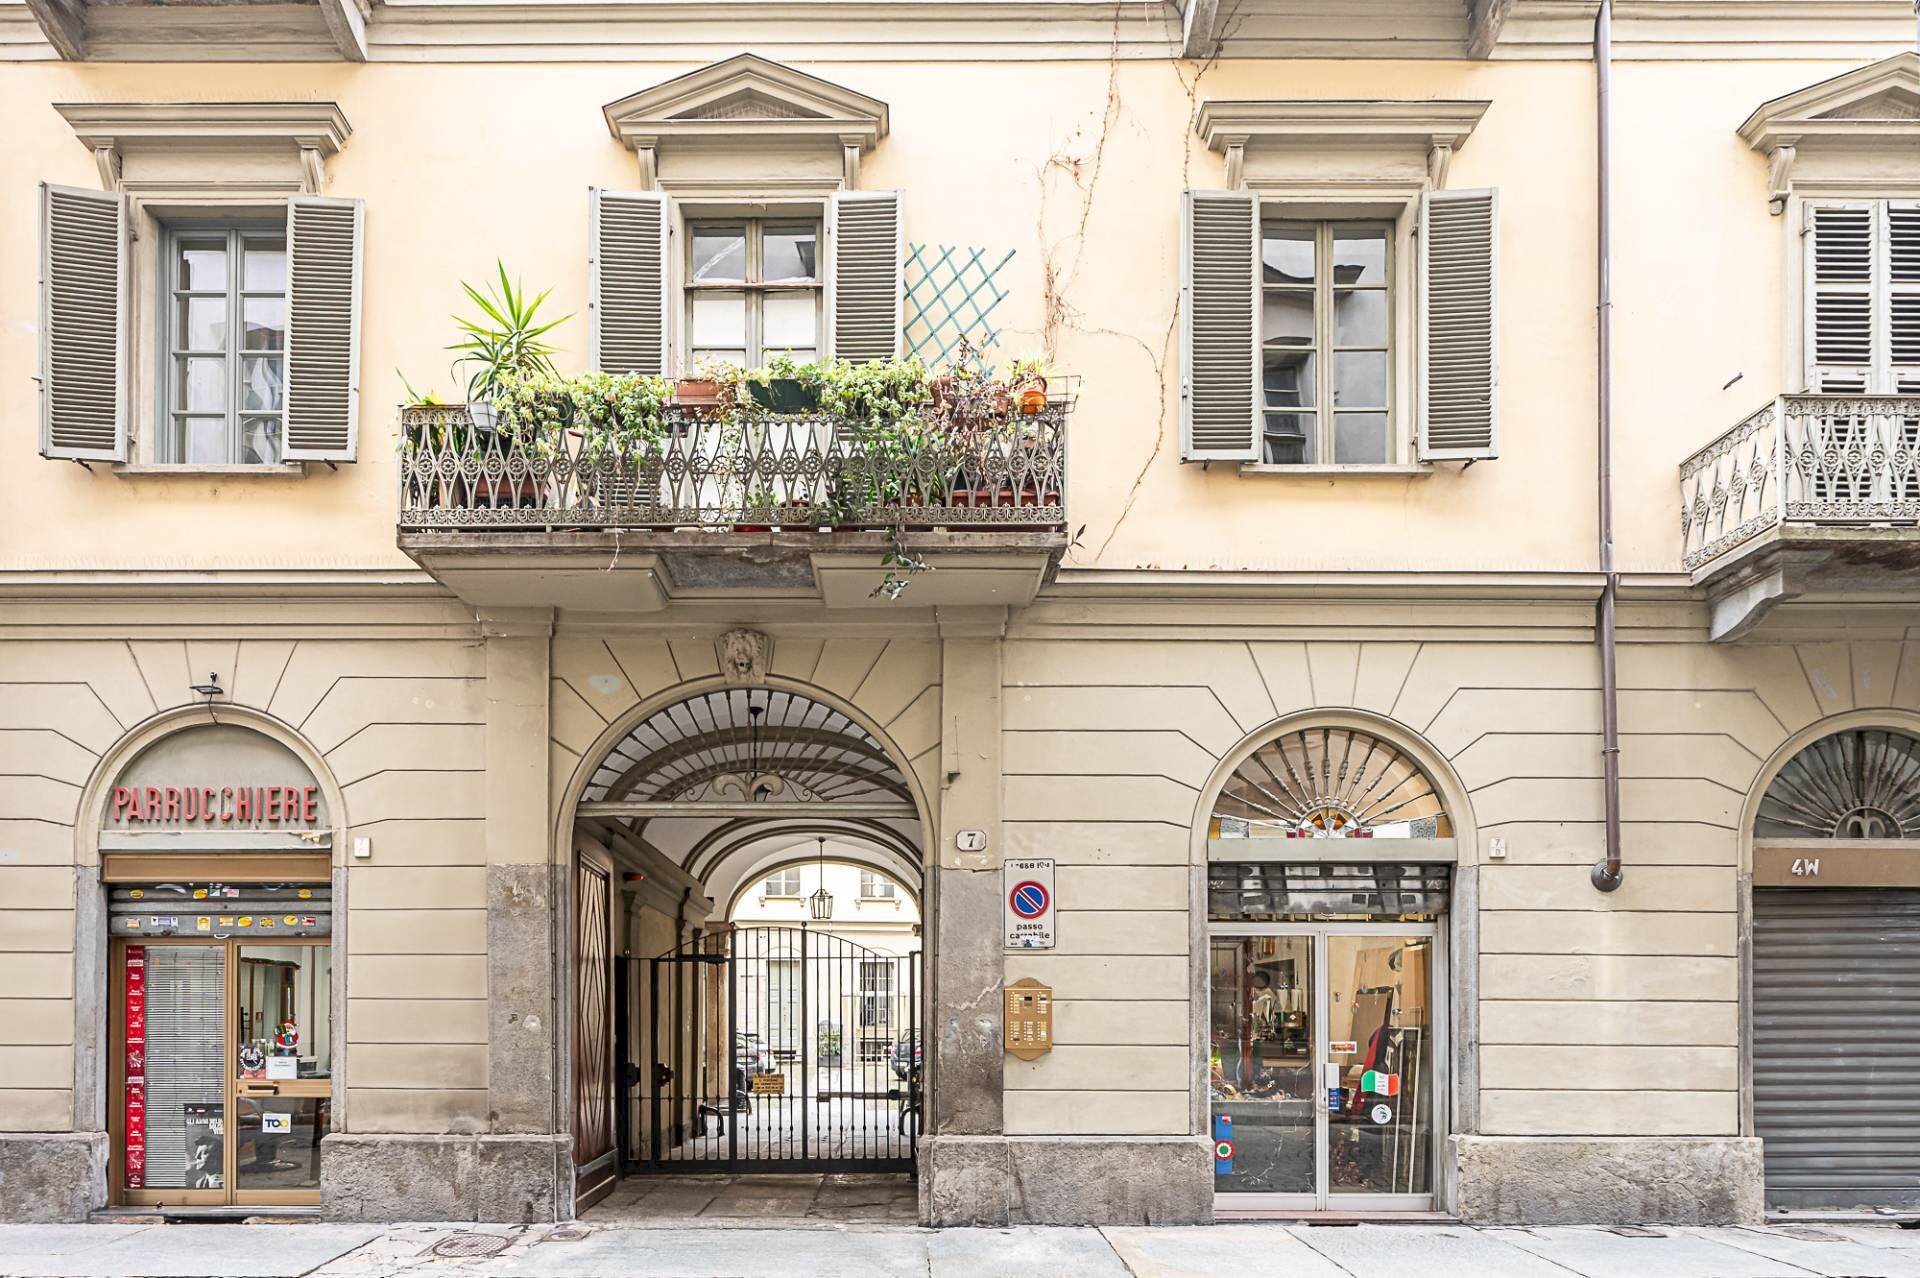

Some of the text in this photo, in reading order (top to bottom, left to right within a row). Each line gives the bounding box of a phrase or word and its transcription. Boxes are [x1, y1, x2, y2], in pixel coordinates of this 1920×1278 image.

[113, 786, 318, 821] PARRUCCHIERE
[967, 833, 976, 848] 7
[1791, 858, 1820, 876] 4W
